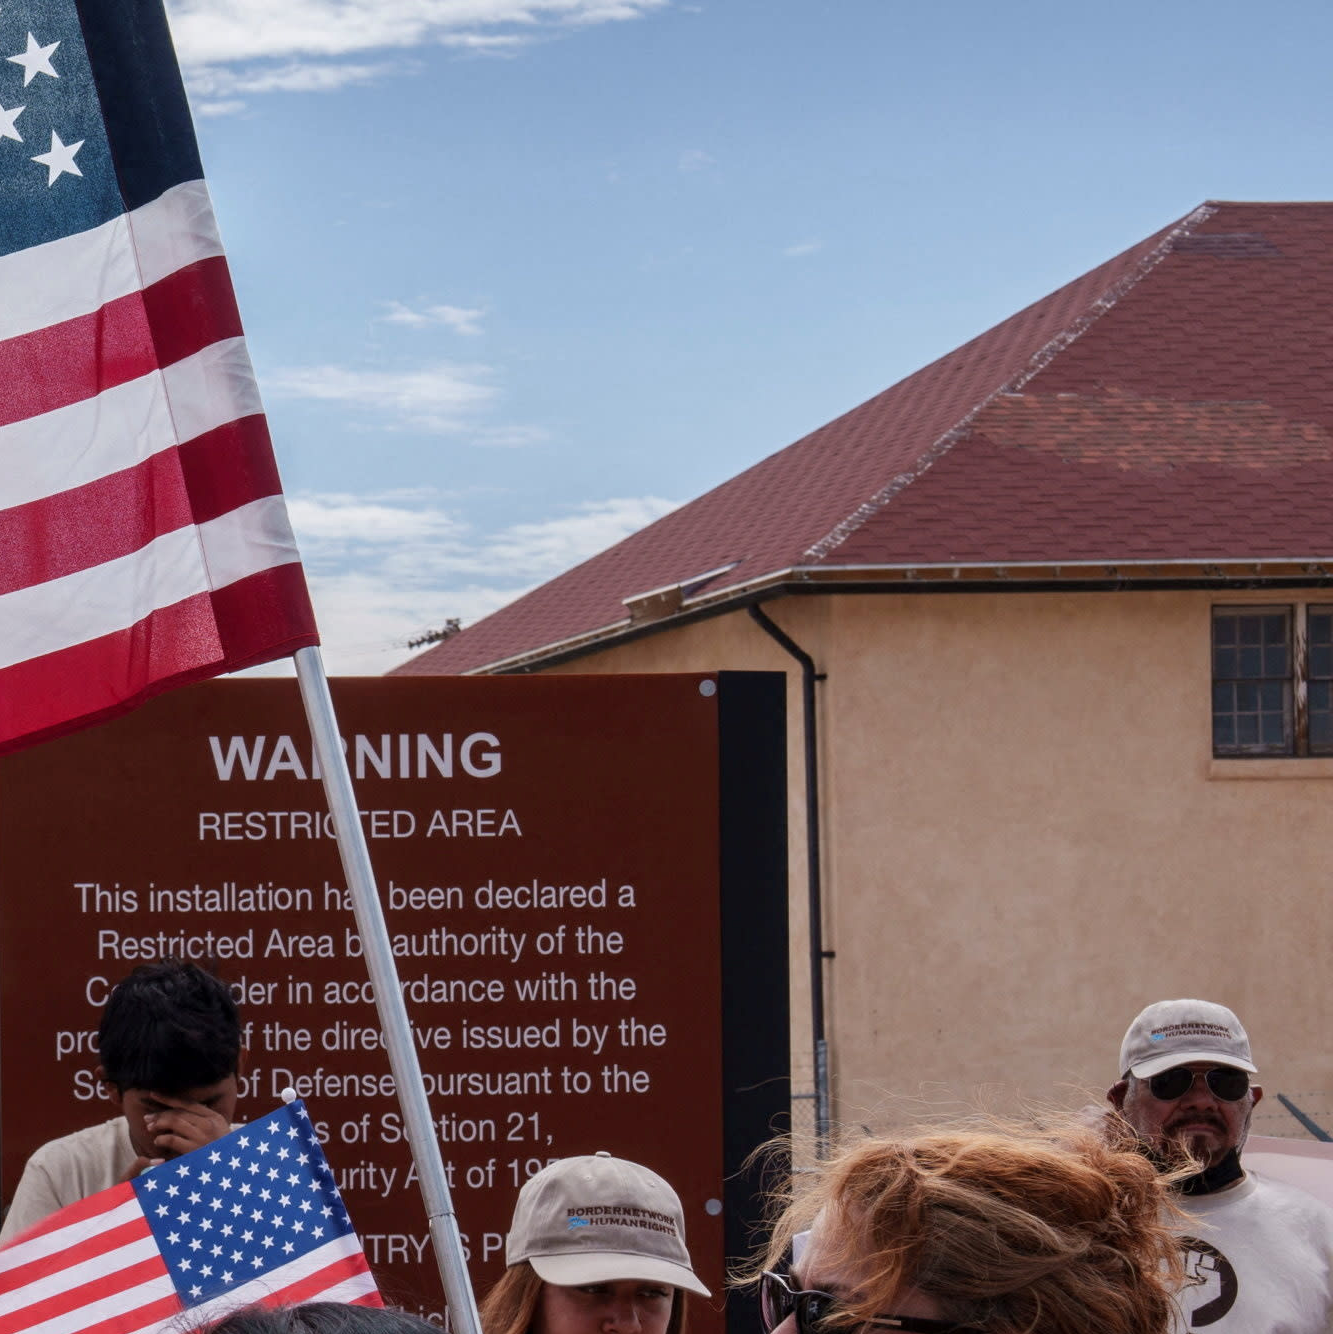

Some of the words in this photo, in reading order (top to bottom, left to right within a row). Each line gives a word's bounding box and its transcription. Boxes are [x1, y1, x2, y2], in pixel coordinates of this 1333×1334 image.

[425, 808, 523, 838] AREA
[73, 882, 139, 913] This
[149, 881, 313, 912] installation
[324, 881, 354, 911] ha
[388, 880, 464, 910] been
[474, 878, 607, 909] declared
[617, 884, 637, 908] a
[97, 928, 254, 959] Restricted
[263, 928, 335, 958] Area
[344, 927, 363, 957] b
[391, 926, 527, 963] authority
[535, 925, 566, 955] of
[575, 924, 624, 954] the
[287, 974, 313, 1005] in
[323, 972, 505, 1005] accrdance
[514, 971, 578, 1001] with
[587, 970, 637, 1000] the
[263, 1021, 312, 1051] the
[321, 1019, 451, 1051] direive
[461, 1018, 561, 1049] issued
[571, 1017, 609, 1055] by
[618, 1017, 667, 1047] the
[236, 1068, 261, 1098] of
[271, 1067, 396, 1098] Defense
[560, 1066, 591, 1095] to
[600, 1064, 651, 1093] the
[340, 1113, 371, 1143] of
[505, 1111, 553, 1146] 21,
[332, 1160, 397, 1197] urity
[404, 1159, 456, 1188] At
[465, 1158, 497, 1188] of
[566, 1206, 676, 1226] BORDERNETWORK
[589, 1217, 677, 1237] HUMANRIGHTS
[361, 1233, 430, 1264] TRY
